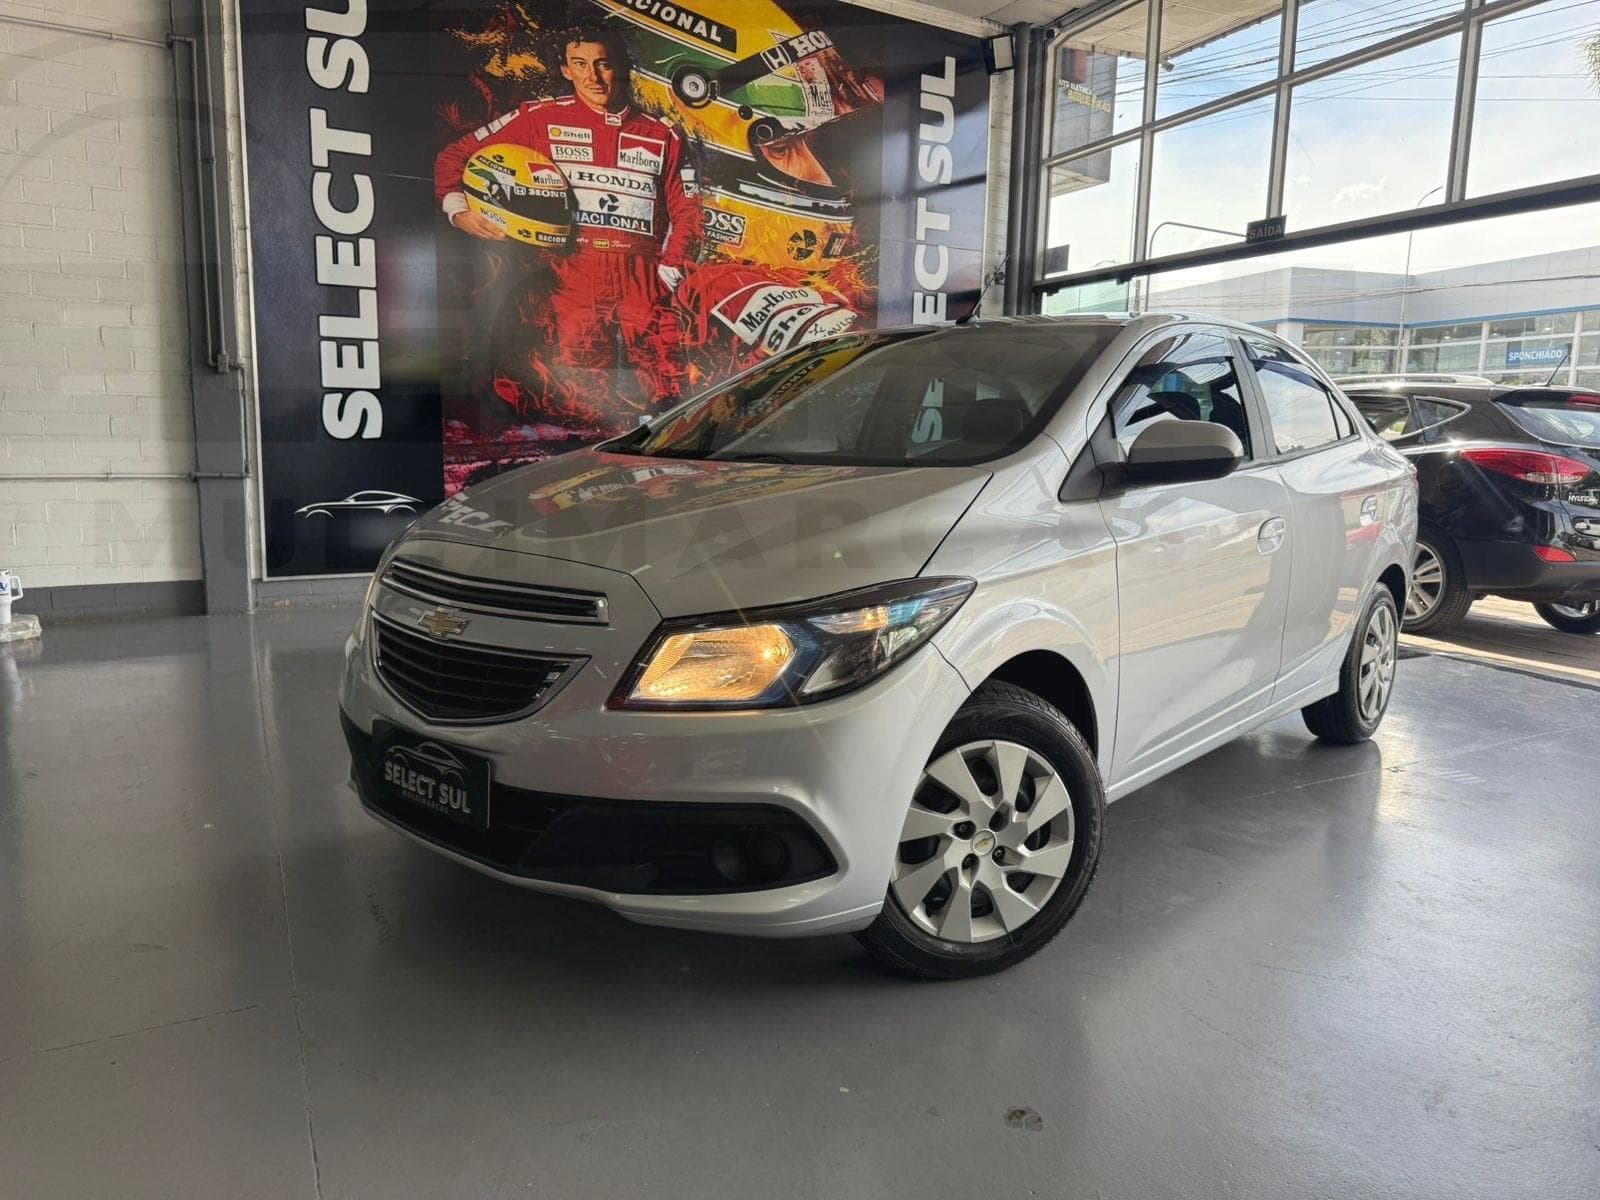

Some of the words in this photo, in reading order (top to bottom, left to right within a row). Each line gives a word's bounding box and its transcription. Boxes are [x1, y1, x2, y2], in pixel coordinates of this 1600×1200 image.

[626, 0, 724, 43] CIONAL
[918, 55, 957, 185] SUL
[563, 130, 591, 140] Shell
[554, 145, 590, 158] BOSS
[619, 150, 661, 169] Marlboro
[576, 170, 654, 194] HONDA
[1248, 224, 1283, 240] SAÍDA
[309, 107, 382, 441] SELECT
[739, 288, 809, 334] Marlboro
[1508, 349, 1563, 361] SPONCHIADO
[384, 760, 436, 799] SELECT
[439, 782, 472, 814] SUL
